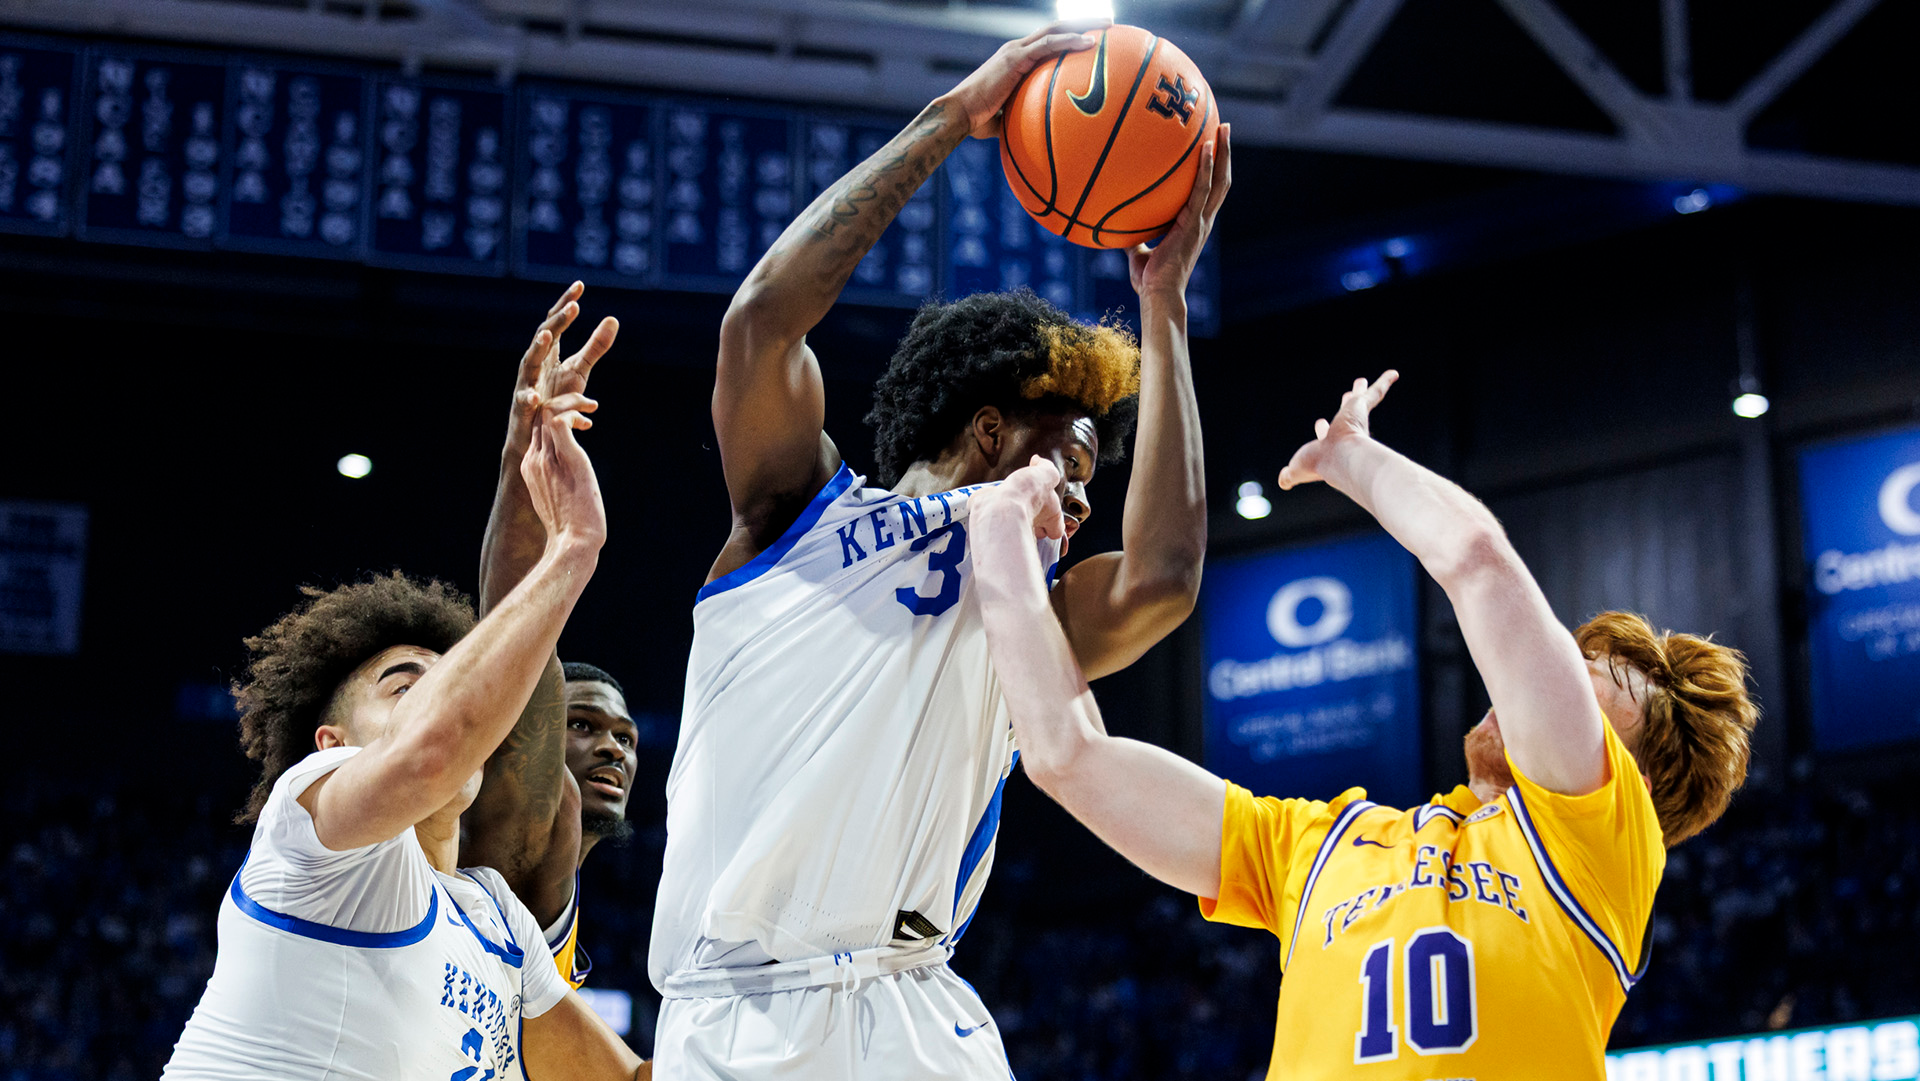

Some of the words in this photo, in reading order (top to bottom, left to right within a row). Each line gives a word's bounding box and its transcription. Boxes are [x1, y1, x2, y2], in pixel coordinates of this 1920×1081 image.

[836, 483, 1000, 569] KENT
[896, 521, 967, 617] 3
[1208, 651, 1323, 700] Central
[1324, 637, 1412, 682] Bank
[1322, 845, 1530, 950] TEESSEE
[1354, 925, 1478, 1064] 10
